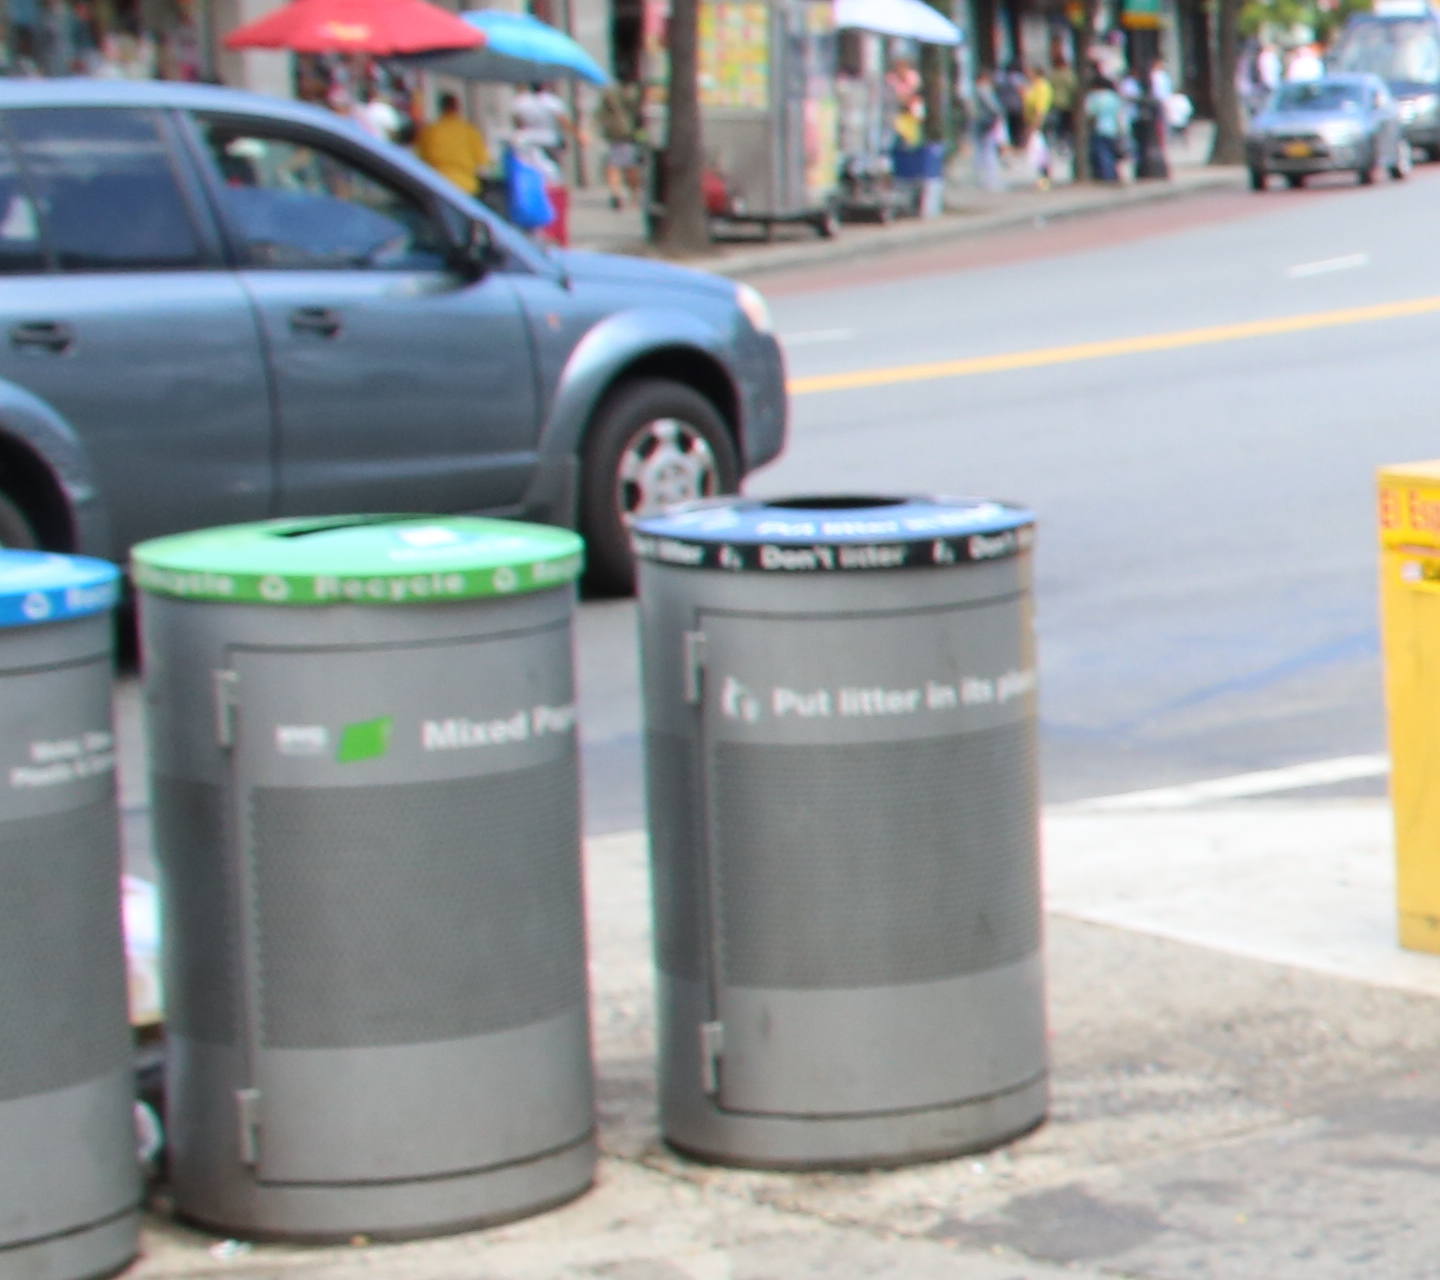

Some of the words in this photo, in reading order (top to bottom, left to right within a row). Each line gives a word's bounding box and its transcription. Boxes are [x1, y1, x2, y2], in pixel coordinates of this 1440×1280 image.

[761, 543, 835, 570] Don't
[838, 543, 907, 569] litter
[314, 570, 464, 601] Recycle
[772, 684, 832, 717] Put
[838, 683, 919, 717] litter
[926, 678, 957, 711] in
[960, 675, 994, 704] its
[422, 710, 530, 751] Mixed
